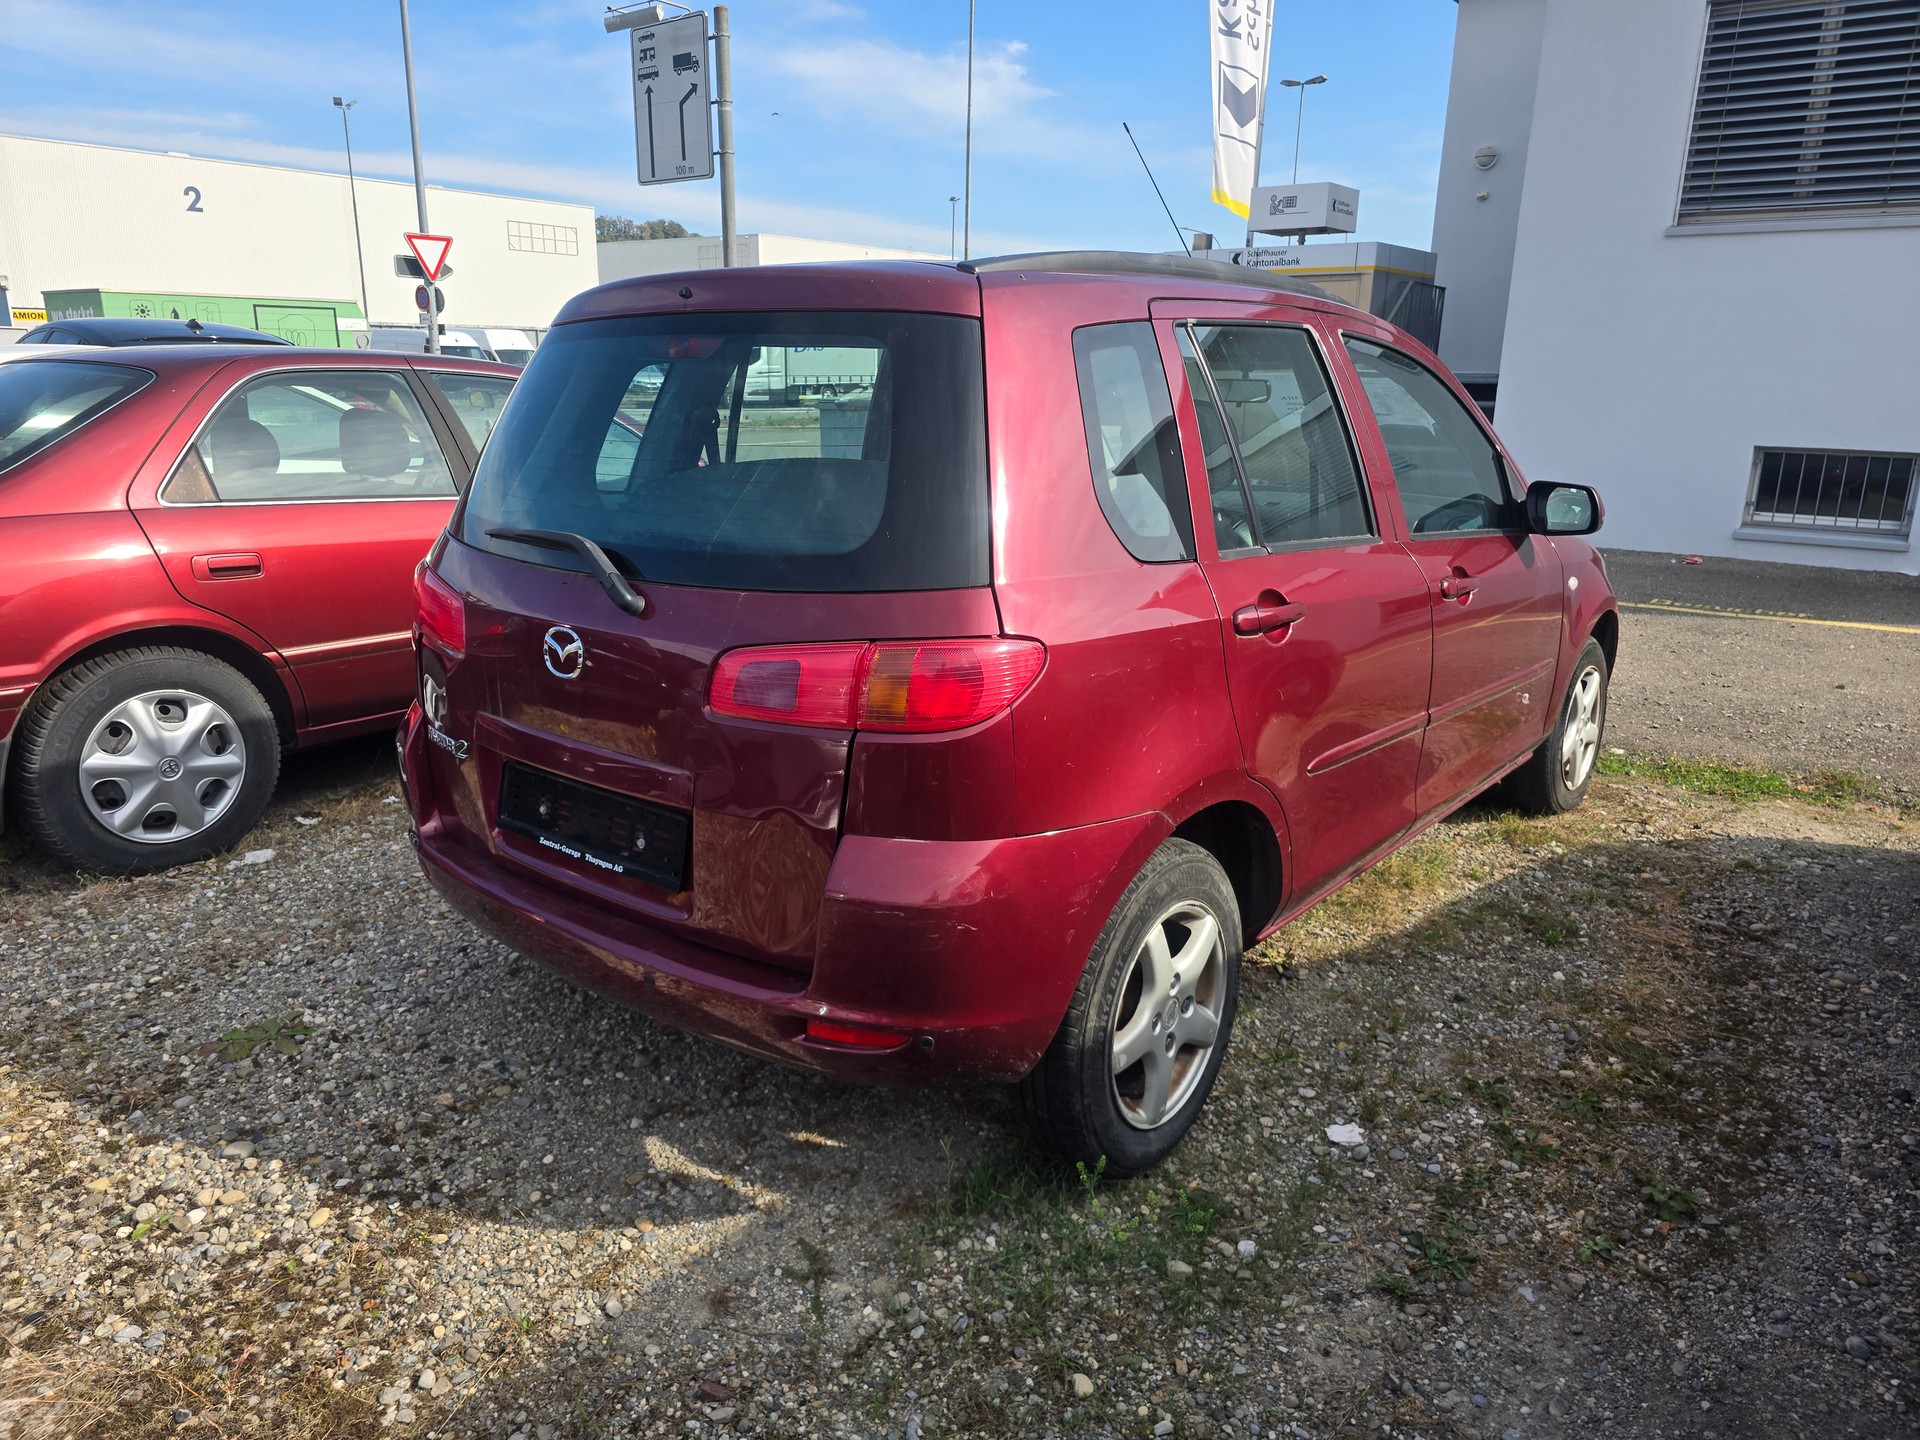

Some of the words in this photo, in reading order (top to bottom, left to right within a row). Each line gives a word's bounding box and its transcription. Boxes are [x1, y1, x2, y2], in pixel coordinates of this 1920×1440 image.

[675, 165, 687, 176] 100
[688, 166, 695, 174] m
[183, 186, 204, 213] 2
[1247, 249, 1288, 258] Schaffhauser
[1246, 257, 1301, 268] Kantonalbank
[539, 836, 582, 859] Zentral-Garage
[585, 853, 613, 870] Thayngen
[613, 863, 624, 873] AG
